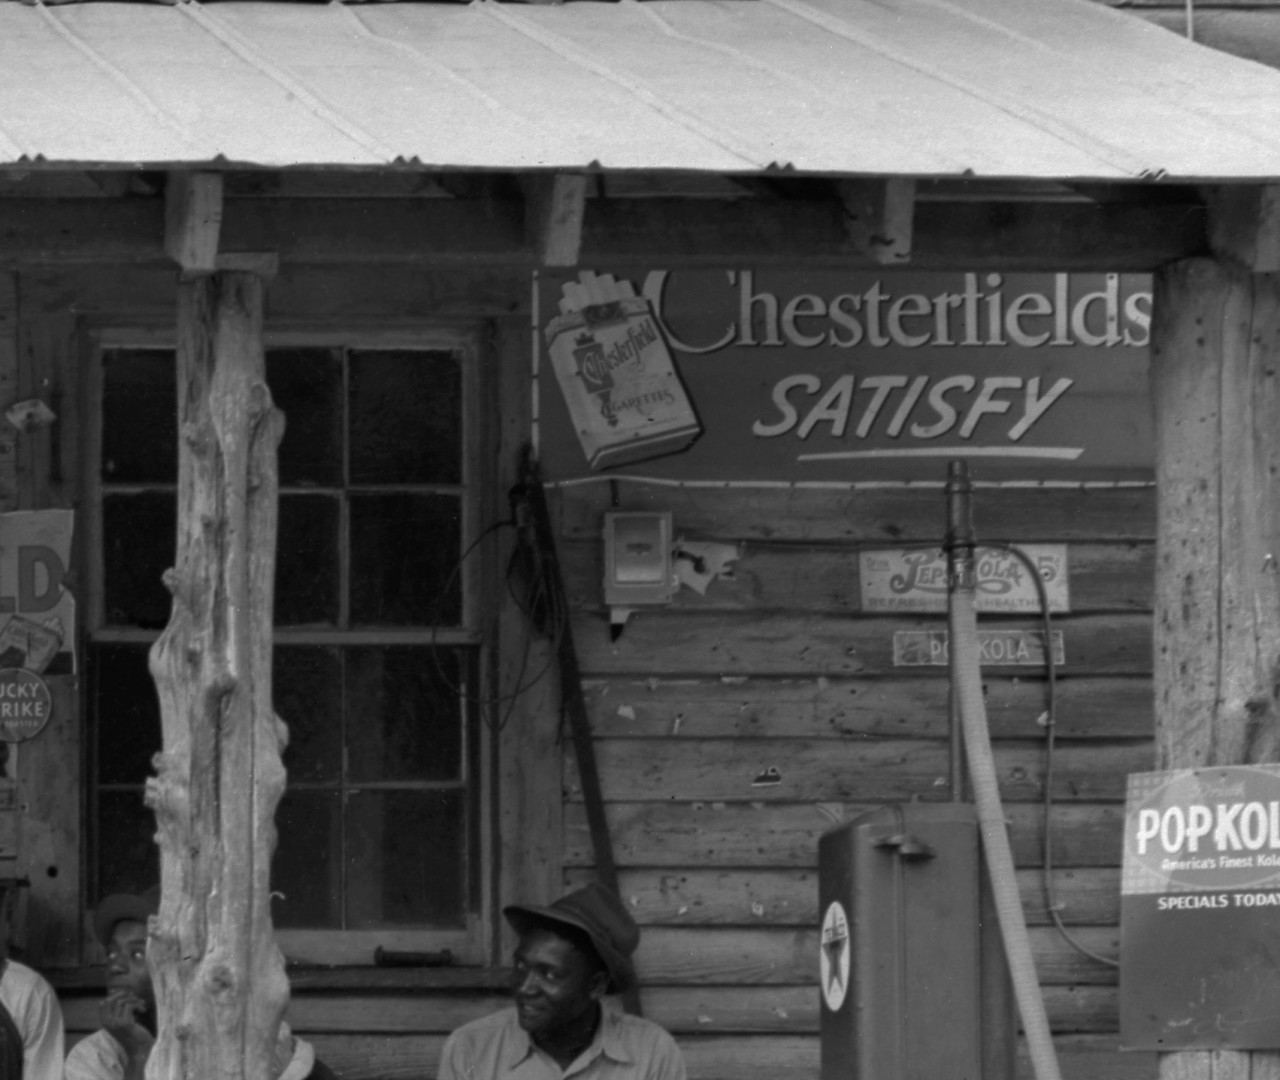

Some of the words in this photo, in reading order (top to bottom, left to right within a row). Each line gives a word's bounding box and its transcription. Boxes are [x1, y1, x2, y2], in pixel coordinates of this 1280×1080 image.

[641, 270, 1151, 352] Chesterfields
[752, 374, 1074, 441] SATISFY
[1136, 805, 1213, 855] POP
[1161, 856, 1217, 871] America's
[1219, 854, 1254, 868] Finest
[1157, 893, 1229, 911] SPECIALS
